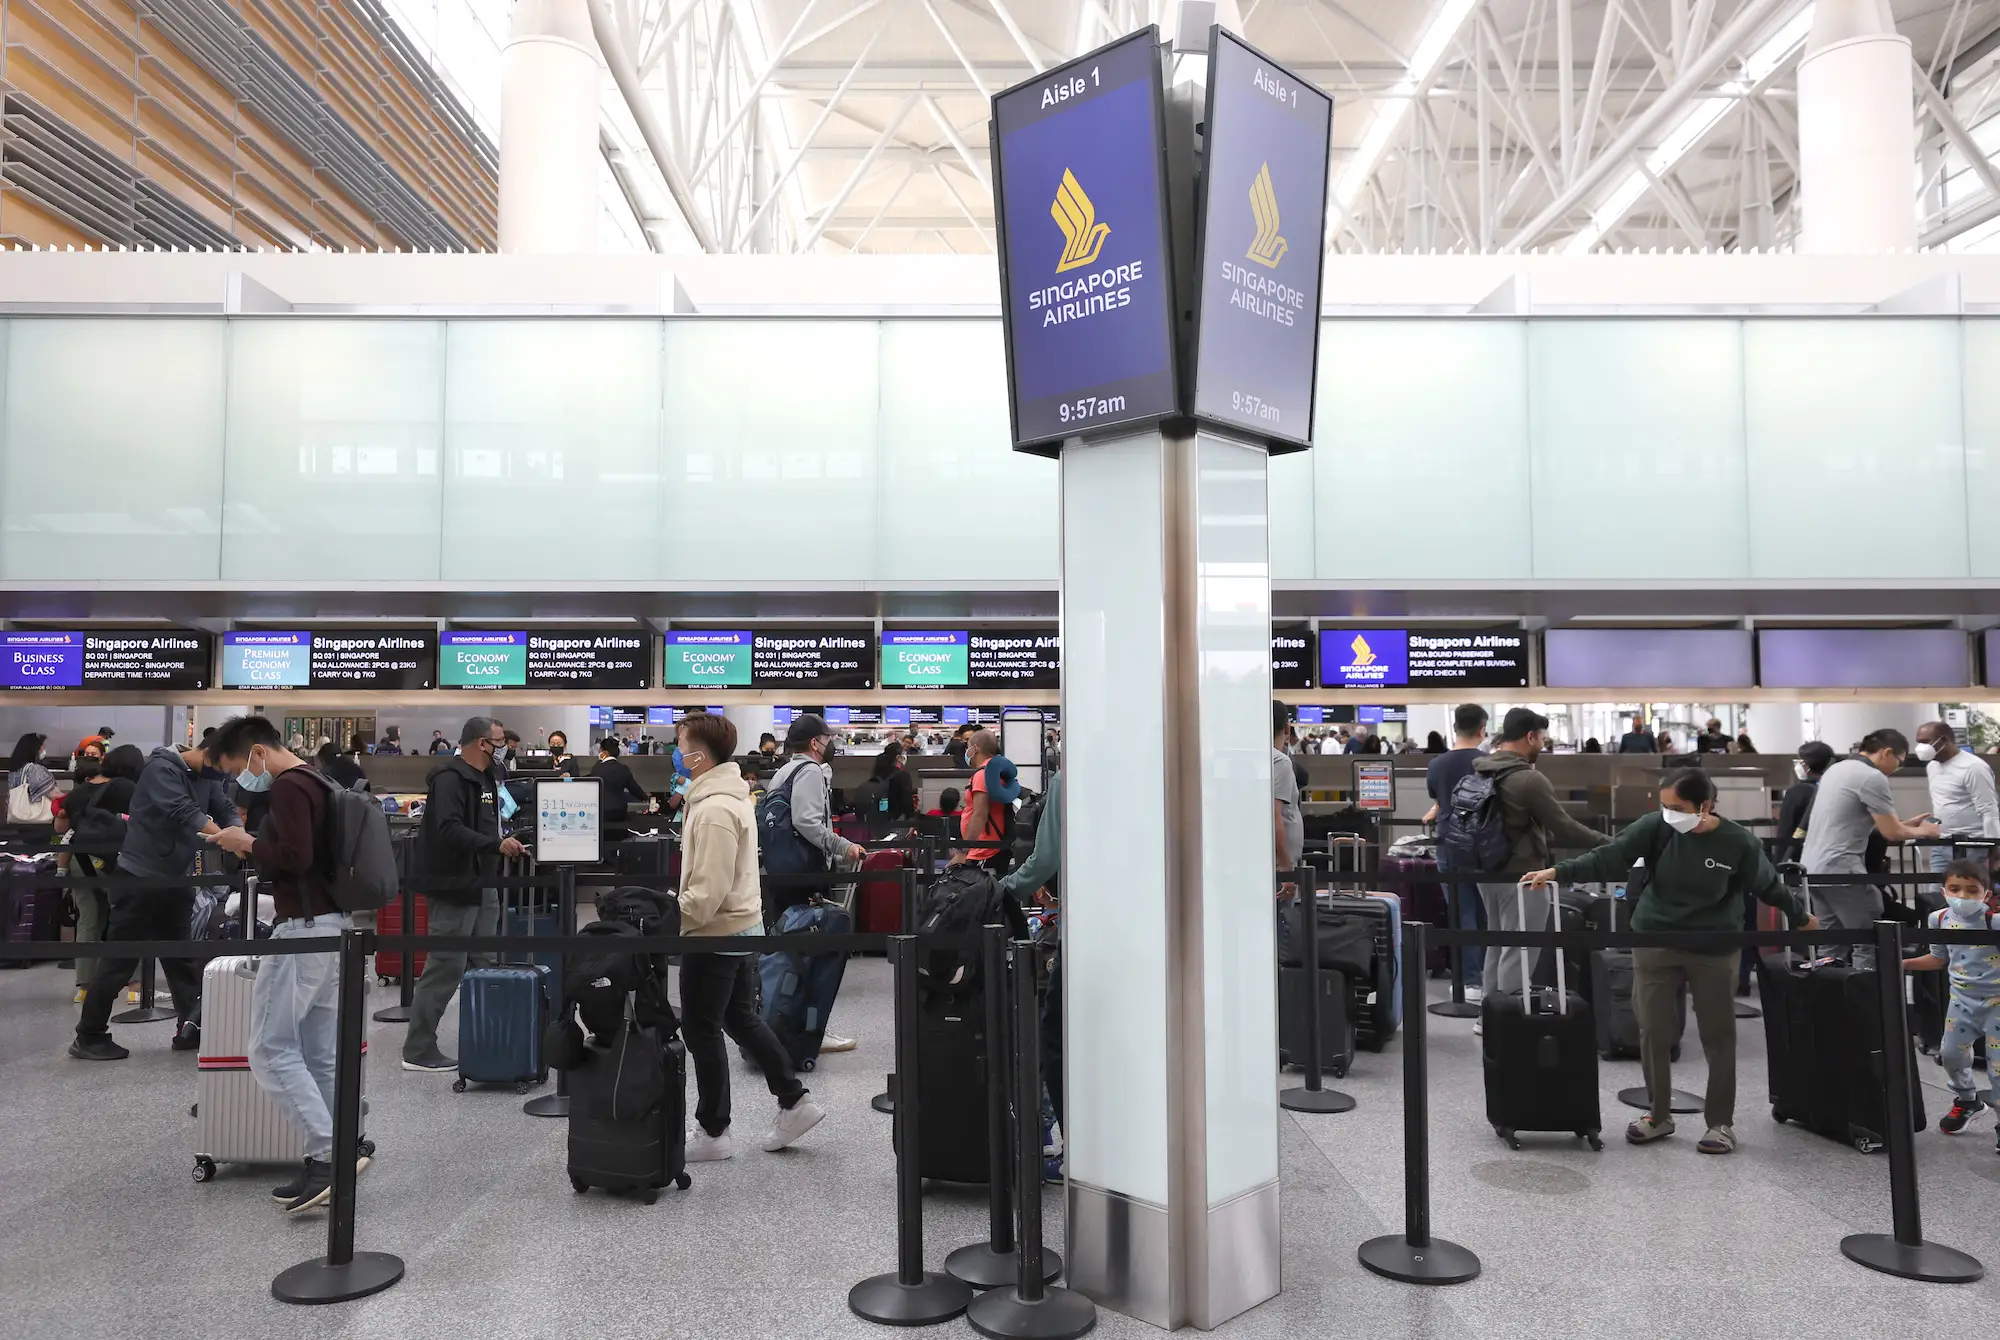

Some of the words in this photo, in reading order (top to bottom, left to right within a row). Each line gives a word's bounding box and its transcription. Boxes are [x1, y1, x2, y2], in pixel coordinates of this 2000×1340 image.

[1040, 74, 1085, 109] Aisle
[1091, 66, 1099, 86] 1
[1253, 68, 1287, 104] Aisle
[1291, 90, 1296, 108] 1
[1029, 261, 1143, 310] SINGAPORE
[1222, 261, 1304, 310] SINGAPORE
[1042, 287, 1131, 327] AIRLINES
[1230, 289, 1294, 327] AIRLINES
[1059, 394, 1125, 423] 9:57am
[1232, 391, 1280, 422] 9:57am
[86, 638, 149, 651] Singapore
[151, 638, 198, 648] Airlines
[313, 637, 375, 651] Singapore
[378, 638, 424, 648] Airlines
[529, 637, 591, 650] Singapore
[594, 637, 640, 648] Airlines
[755, 637, 817, 650] Singapore
[819, 637, 866, 648] Airlines
[970, 637, 1032, 650] Singapore
[1035, 637, 1059, 647] Airli
[1272, 637, 1305, 648] rlines
[1409, 636, 1471, 650] Singapore
[1473, 636, 1520, 647] Airlines
[14, 652, 64, 663] BUSINESS
[245, 648, 289, 658] PREMIUM
[457, 652, 510, 662] ECONOMY
[683, 652, 735, 662] ECONOMY
[899, 652, 951, 662] ECONOMY
[22, 664, 56, 675] CLASS
[242, 659, 291, 669] ECONOMY
[466, 664, 500, 674] CLASS
[692, 664, 725, 674] CLASS
[908, 664, 942, 674] CLASS
[1048, 661, 1056, 669] @
[251, 670, 281, 680] CLASS
[354, 671, 361, 679] @
